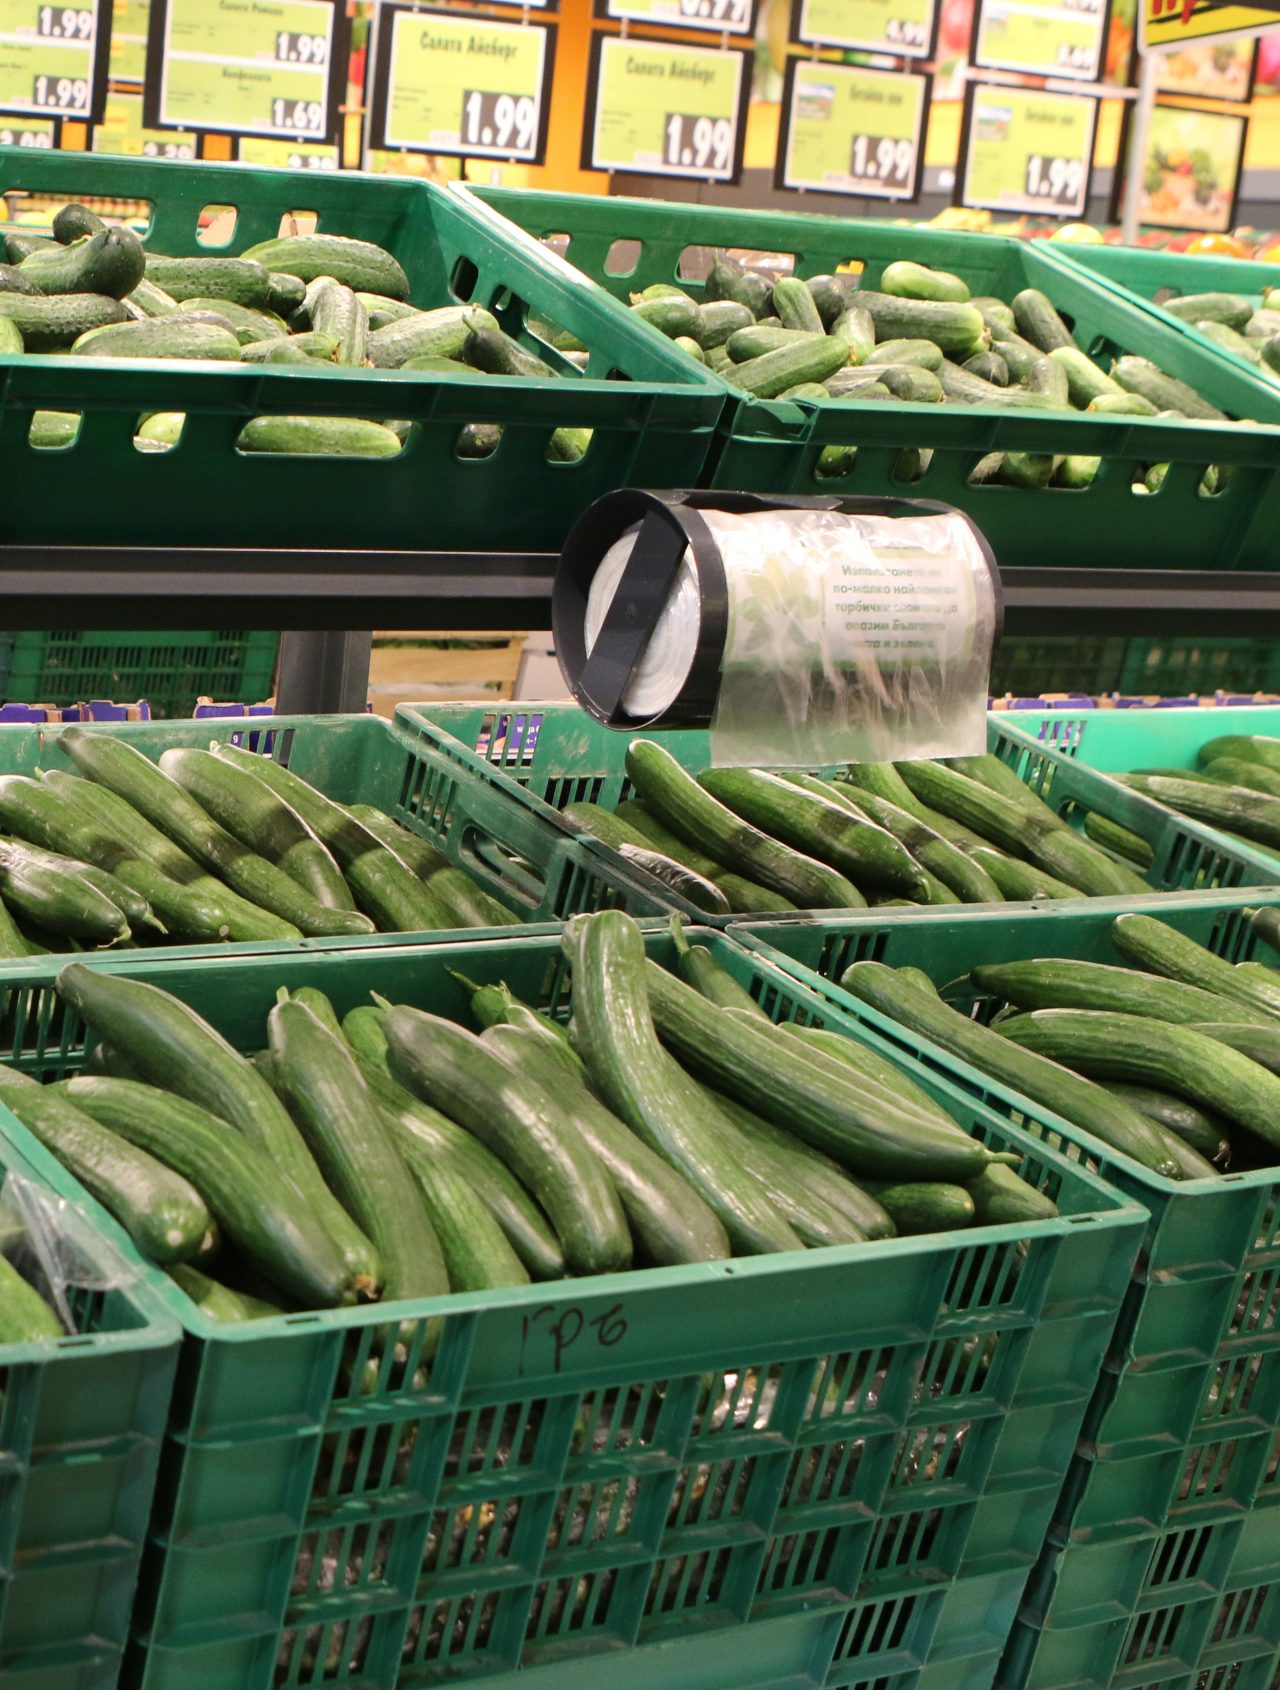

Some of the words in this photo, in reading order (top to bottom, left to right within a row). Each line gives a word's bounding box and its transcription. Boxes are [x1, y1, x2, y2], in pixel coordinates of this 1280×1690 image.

[40, 6, 92, 40] 1.99
[278, 31, 326, 64] 1.99
[420, 30, 463, 53] Салата
[467, 35, 518, 64] Айсберг
[36, 75, 88, 109] 1.99
[273, 98, 321, 130] 1.69
[465, 90, 536, 149] 1.99
[667, 113, 732, 170] 1.99
[853, 134, 913, 181] 1.99
[1028, 154, 1084, 199] 1.99
